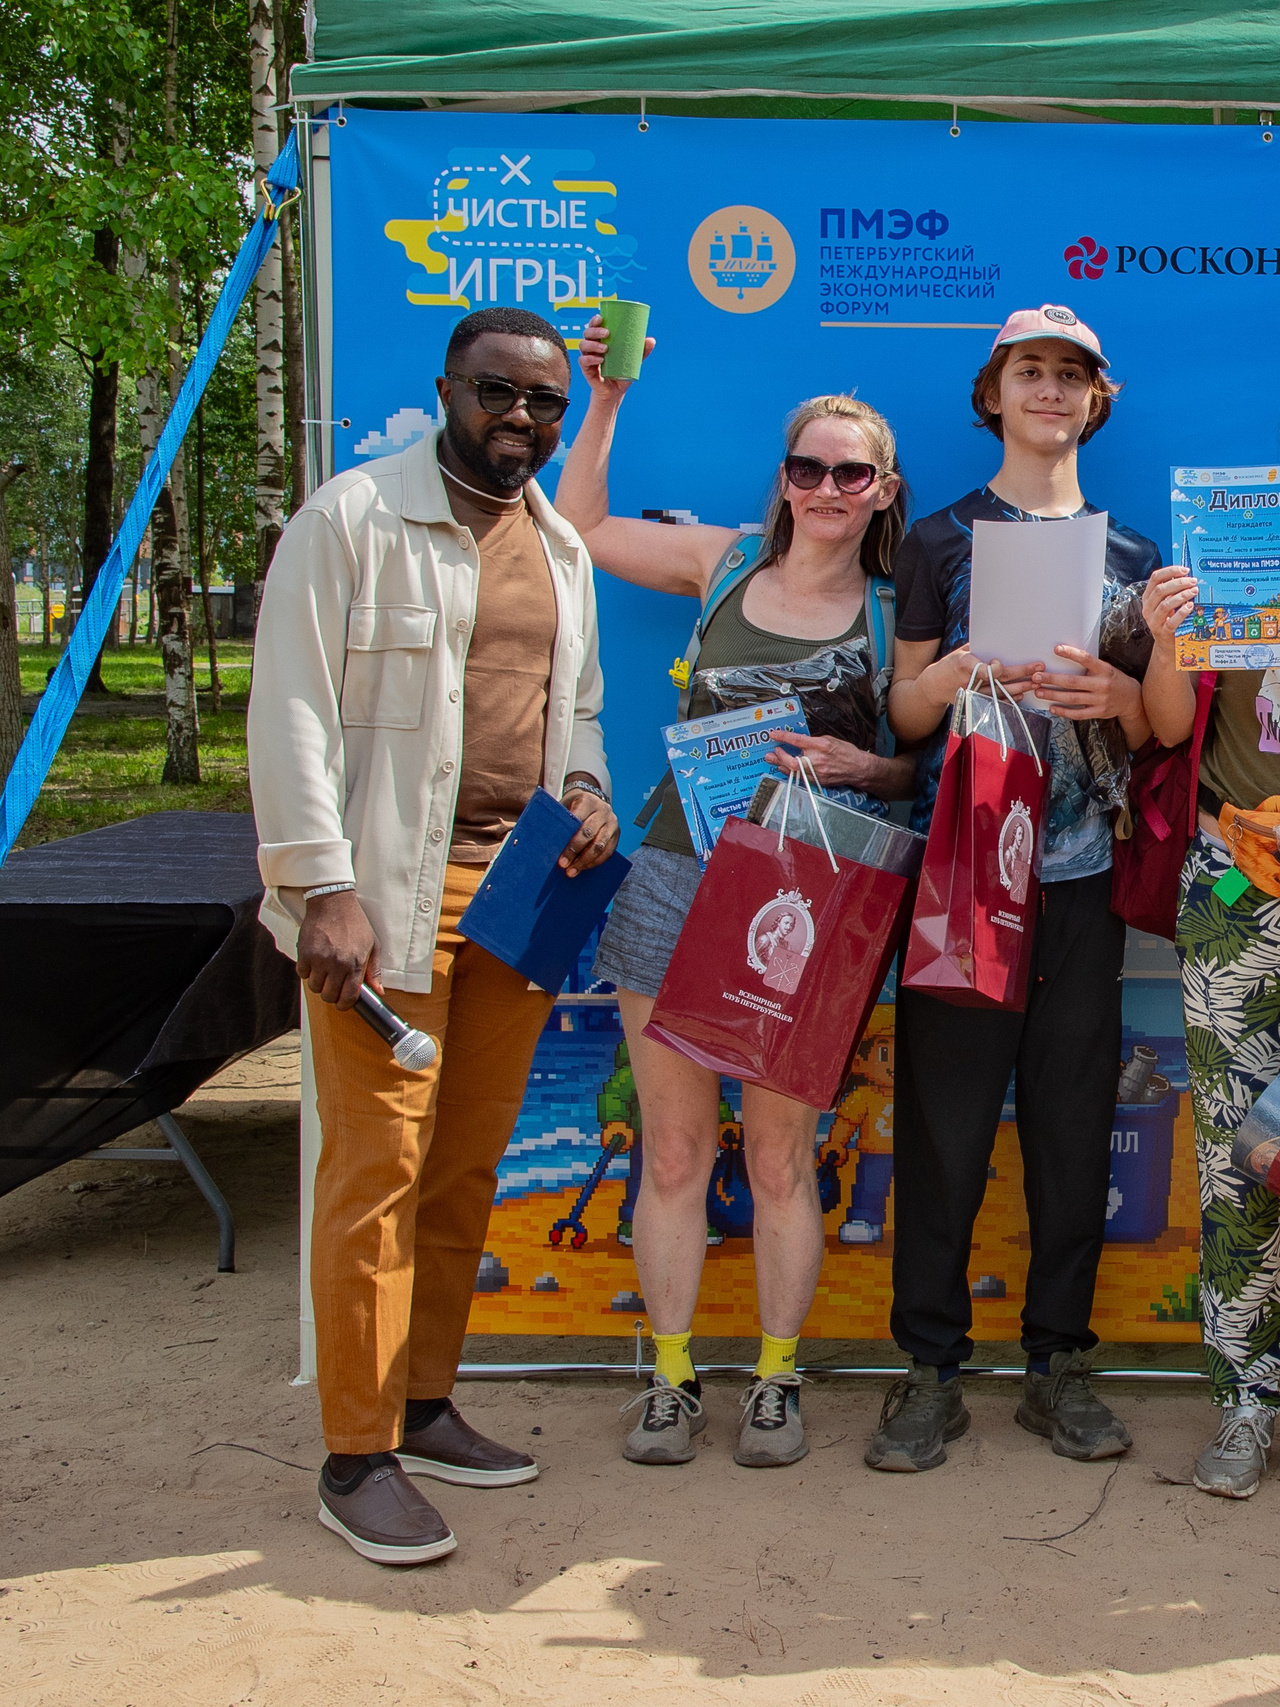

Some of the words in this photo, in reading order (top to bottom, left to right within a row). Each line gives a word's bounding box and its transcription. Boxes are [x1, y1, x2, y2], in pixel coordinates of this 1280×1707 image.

[448, 198, 587, 230] ЧИСТЫЕ
[820, 208, 950, 241] ПМЭФ
[820, 243, 975, 263] ПЕТЕРБУРГСКИЙ
[448, 258, 587, 303] ИГРЫ
[820, 262, 1001, 282] МЕЖДУНАРОДНЫЙ
[820, 280, 996, 299] ЭКОНОМИЧЕСКИЙ
[820, 300, 890, 318] ФОРУМ
[1226, 521, 1273, 530] Награждается
[1207, 560, 1232, 568] Чистые
[1233, 560, 1251, 570] Игры
[1260, 559, 1280, 568] ПМЭФ
[718, 804, 741, 814] Чистые
[722, 992, 741, 1004] КЛУБ
[740, 998, 793, 1023] ПЕТЕРБУРЖЦЕВ
[738, 990, 782, 1010] ВСЕМИРНЫЙ
